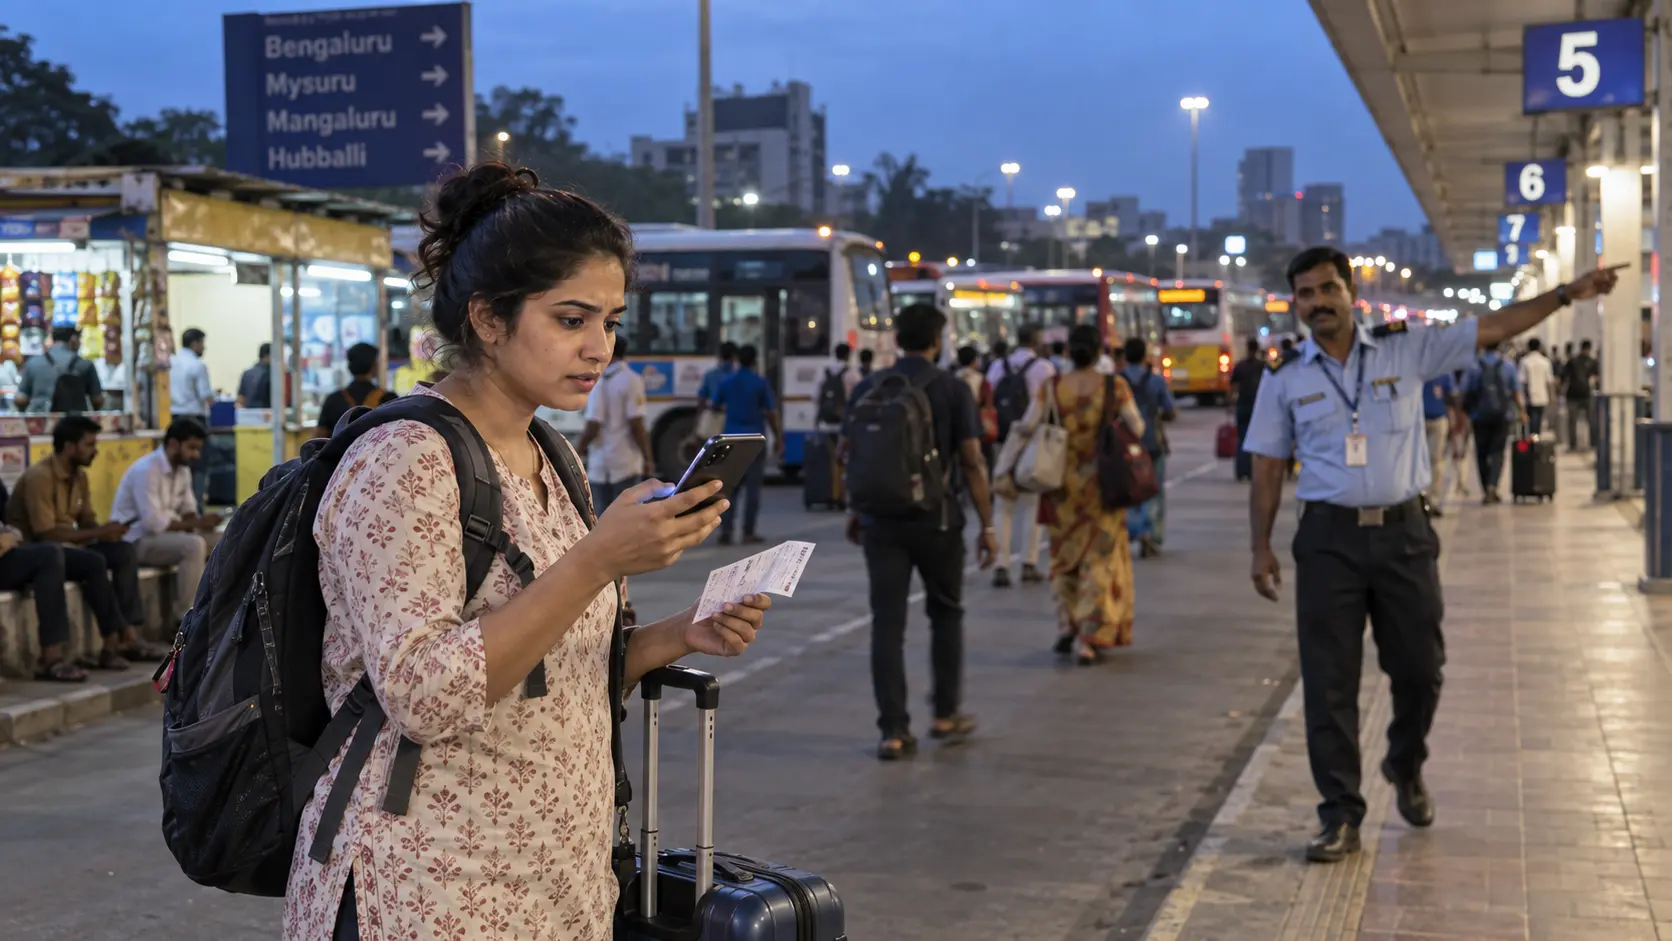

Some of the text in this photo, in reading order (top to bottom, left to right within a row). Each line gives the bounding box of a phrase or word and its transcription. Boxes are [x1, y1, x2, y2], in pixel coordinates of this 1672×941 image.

[265, 30, 393, 62] Bengaluru
[1556, 30, 1601, 98] 5
[266, 72, 356, 100] Mysuru
[267, 106, 397, 137] Mangaluru
[268, 143, 366, 170] Hubballi
[1519, 163, 1545, 201] 6
[1506, 214, 1526, 242] 7
